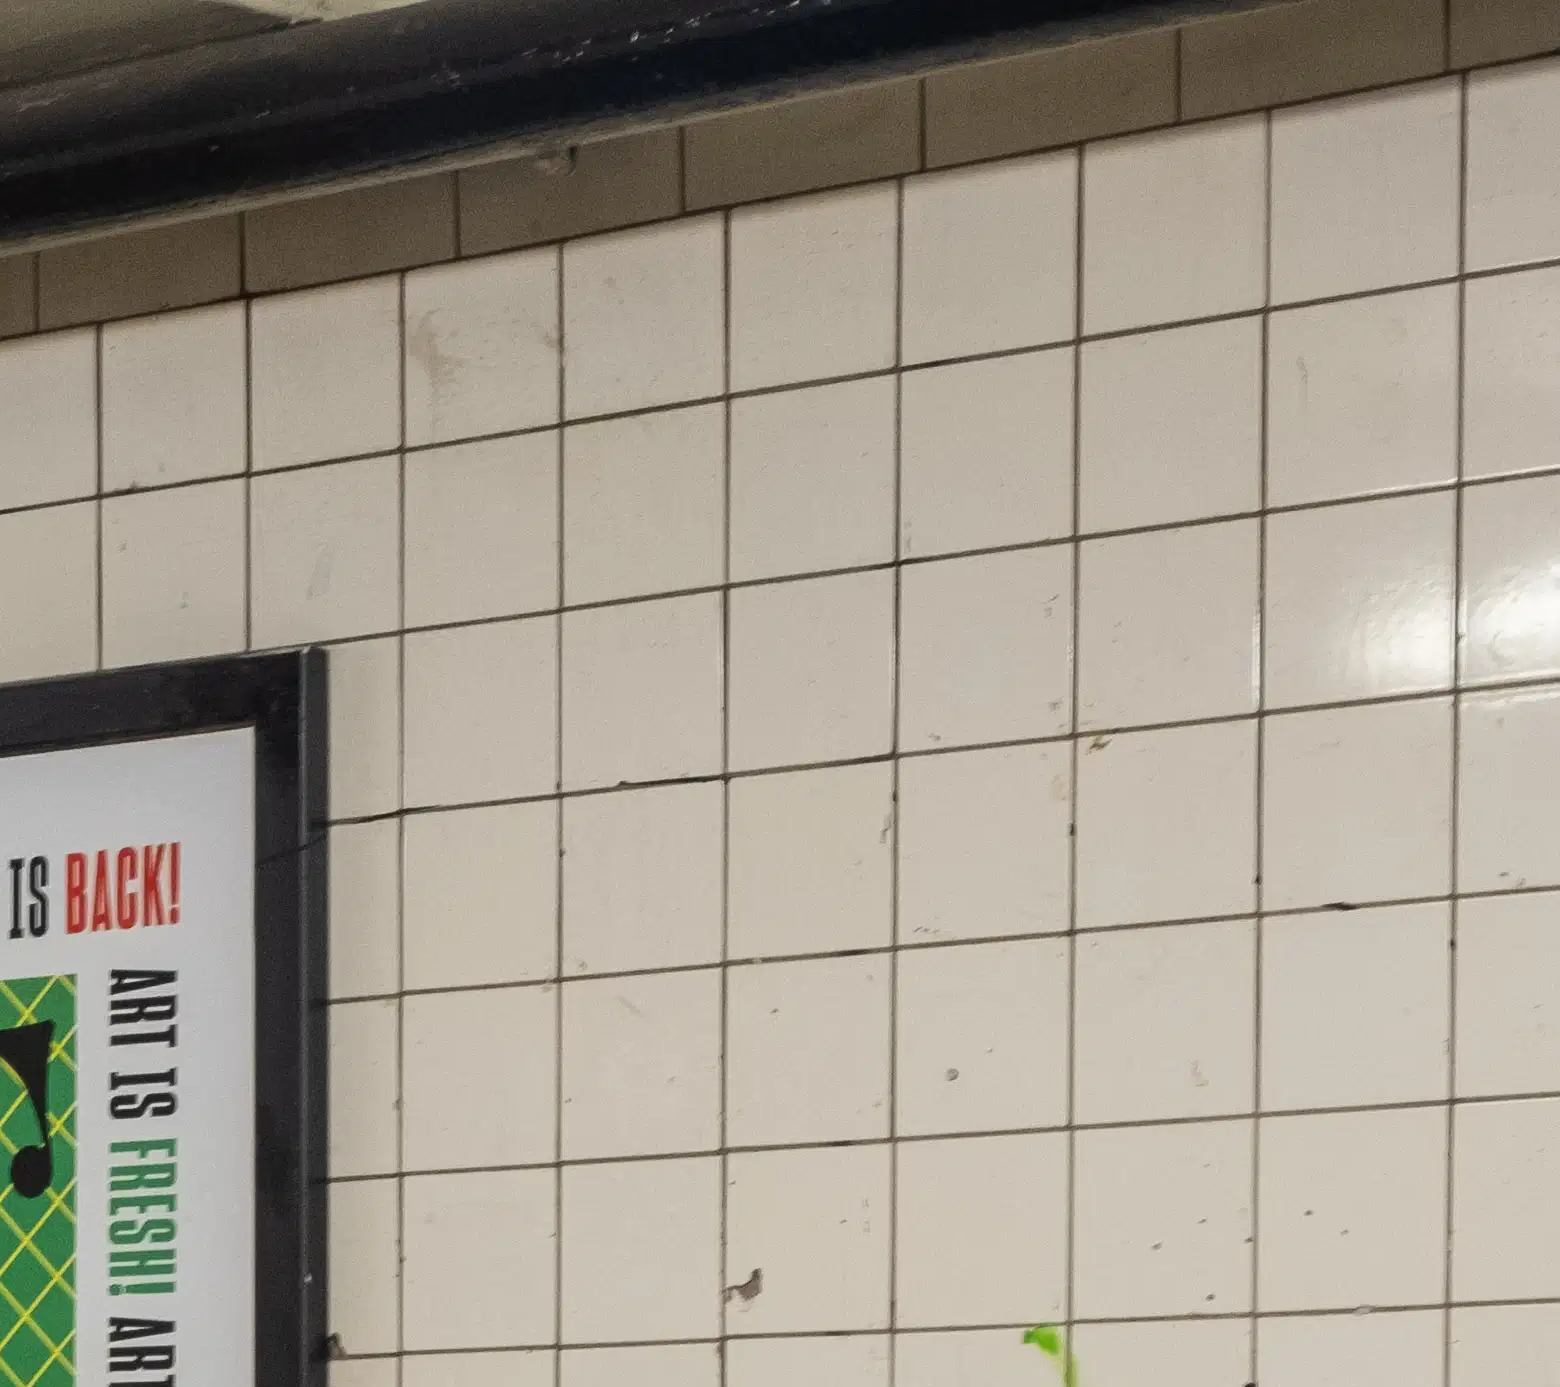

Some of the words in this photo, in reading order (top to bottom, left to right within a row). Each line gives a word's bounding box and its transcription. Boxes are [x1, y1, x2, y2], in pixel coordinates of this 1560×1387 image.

[8, 856, 49, 940] IS
[65, 842, 180, 935] BACK!
[109, 969, 178, 1047] ART
[109, 1067, 177, 1120] IS
[108, 1138, 177, 1296] FRESH!
